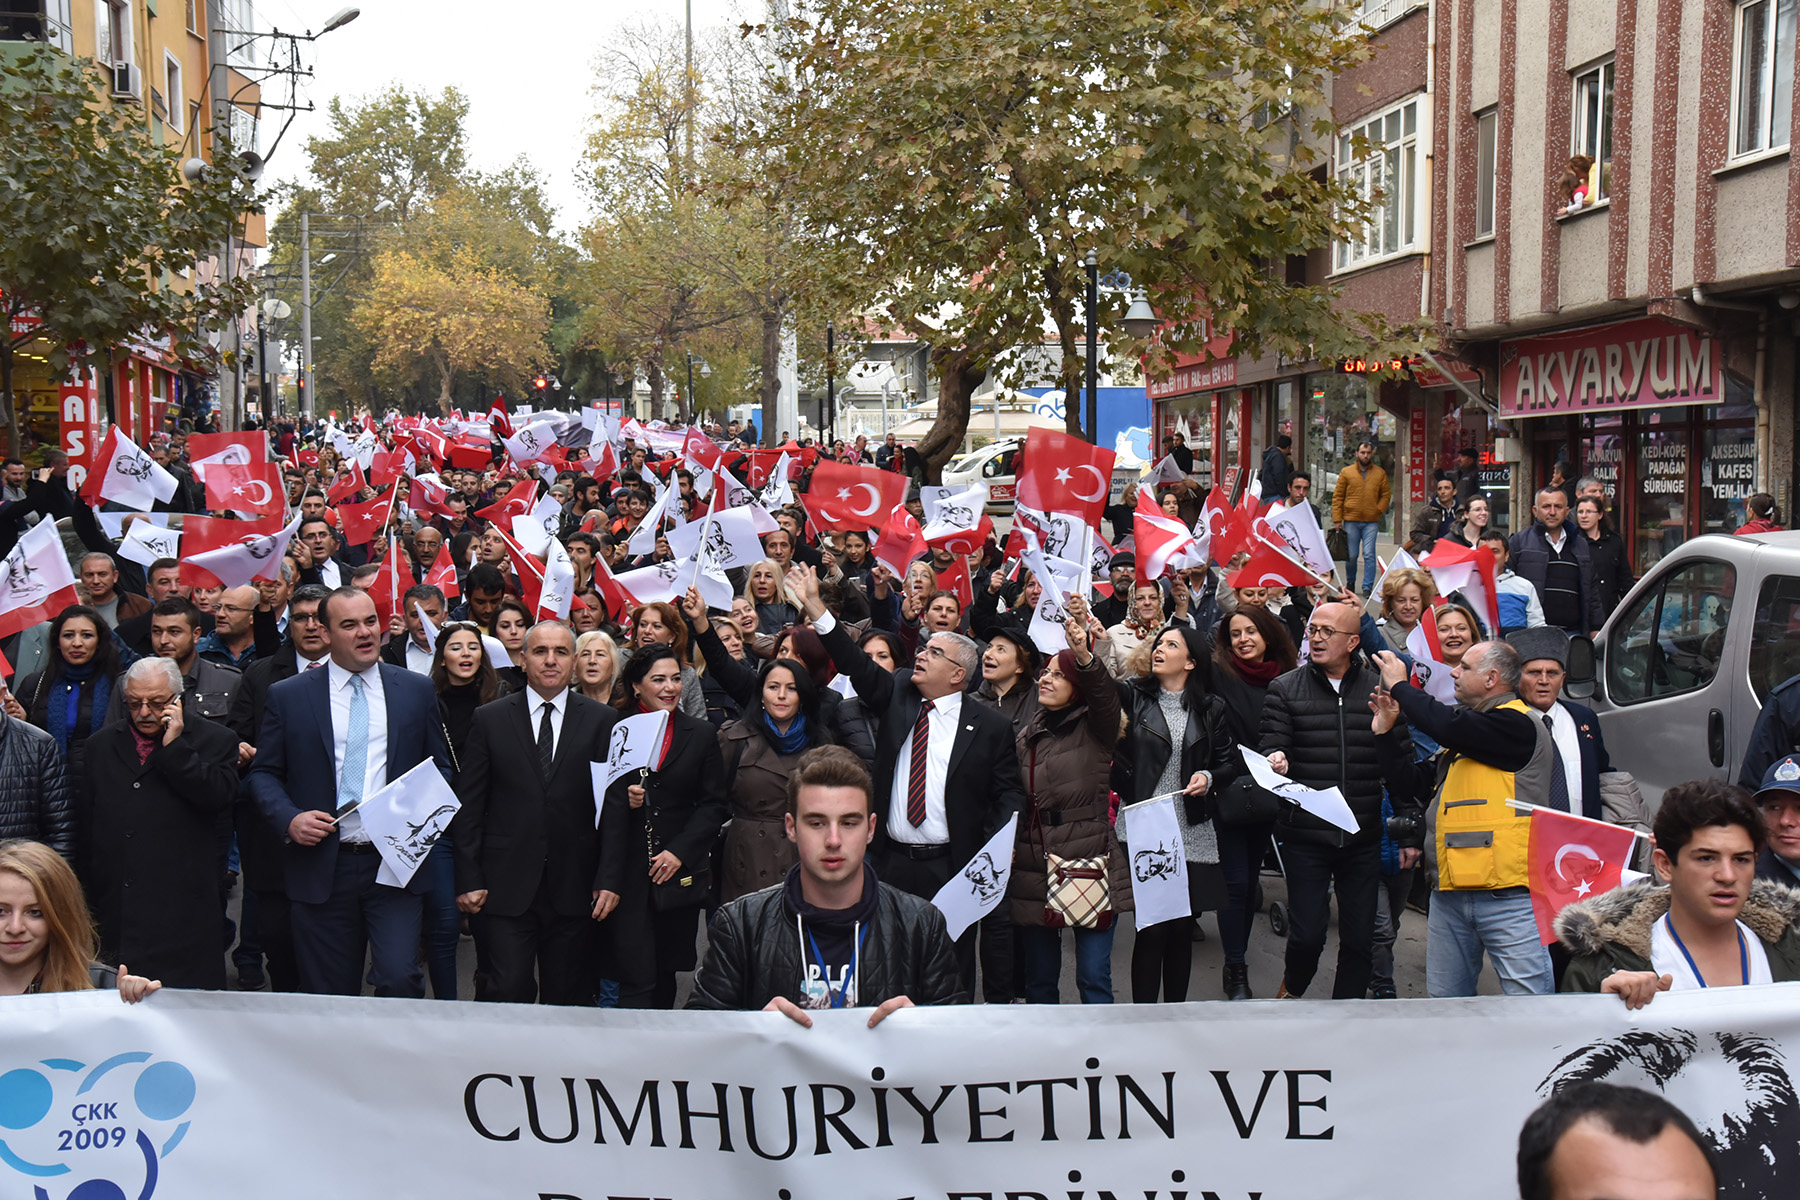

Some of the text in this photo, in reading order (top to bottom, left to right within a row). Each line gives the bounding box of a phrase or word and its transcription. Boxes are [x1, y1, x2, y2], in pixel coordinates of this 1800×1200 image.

[1515, 333, 1713, 409] AKVARYUM
[1593, 467, 1618, 480] BALIK
[1718, 463, 1753, 479] KAFES
[71, 1102, 118, 1126] ÇKK
[463, 1057, 1335, 1160] CUMHURİYETİN VE
[57, 1127, 126, 1151] 2009
